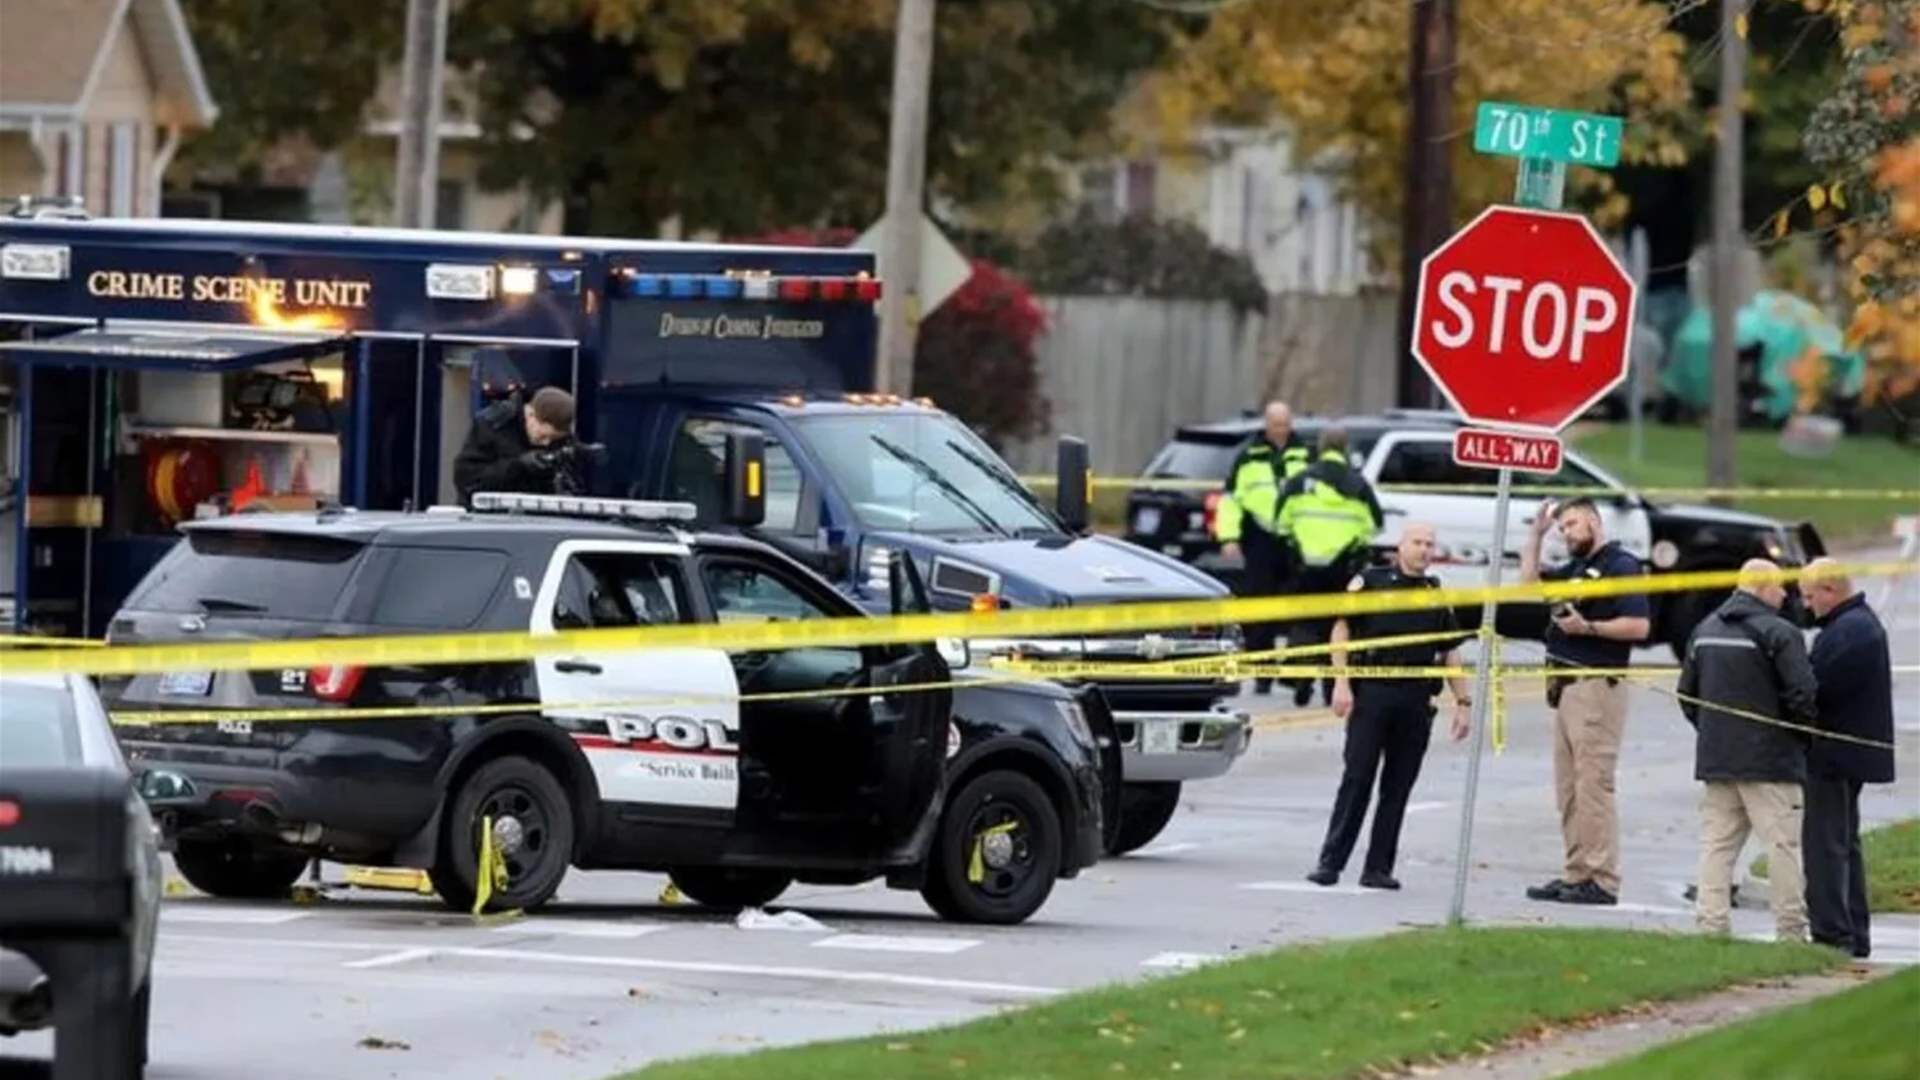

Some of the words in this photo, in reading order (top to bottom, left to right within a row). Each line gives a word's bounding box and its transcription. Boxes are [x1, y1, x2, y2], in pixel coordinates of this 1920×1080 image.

[1490, 108, 1551, 151] 70th
[1569, 119, 1607, 161] St
[87, 271, 184, 299] CRIME
[192, 275, 286, 303] SCENE
[295, 280, 371, 307] UNIT
[1431, 271, 1618, 363] STOP
[1462, 436, 1499, 459] ALL
[1511, 440, 1553, 465] WAY
[217, 719, 253, 734] POLICE
[605, 713, 740, 750] POL
